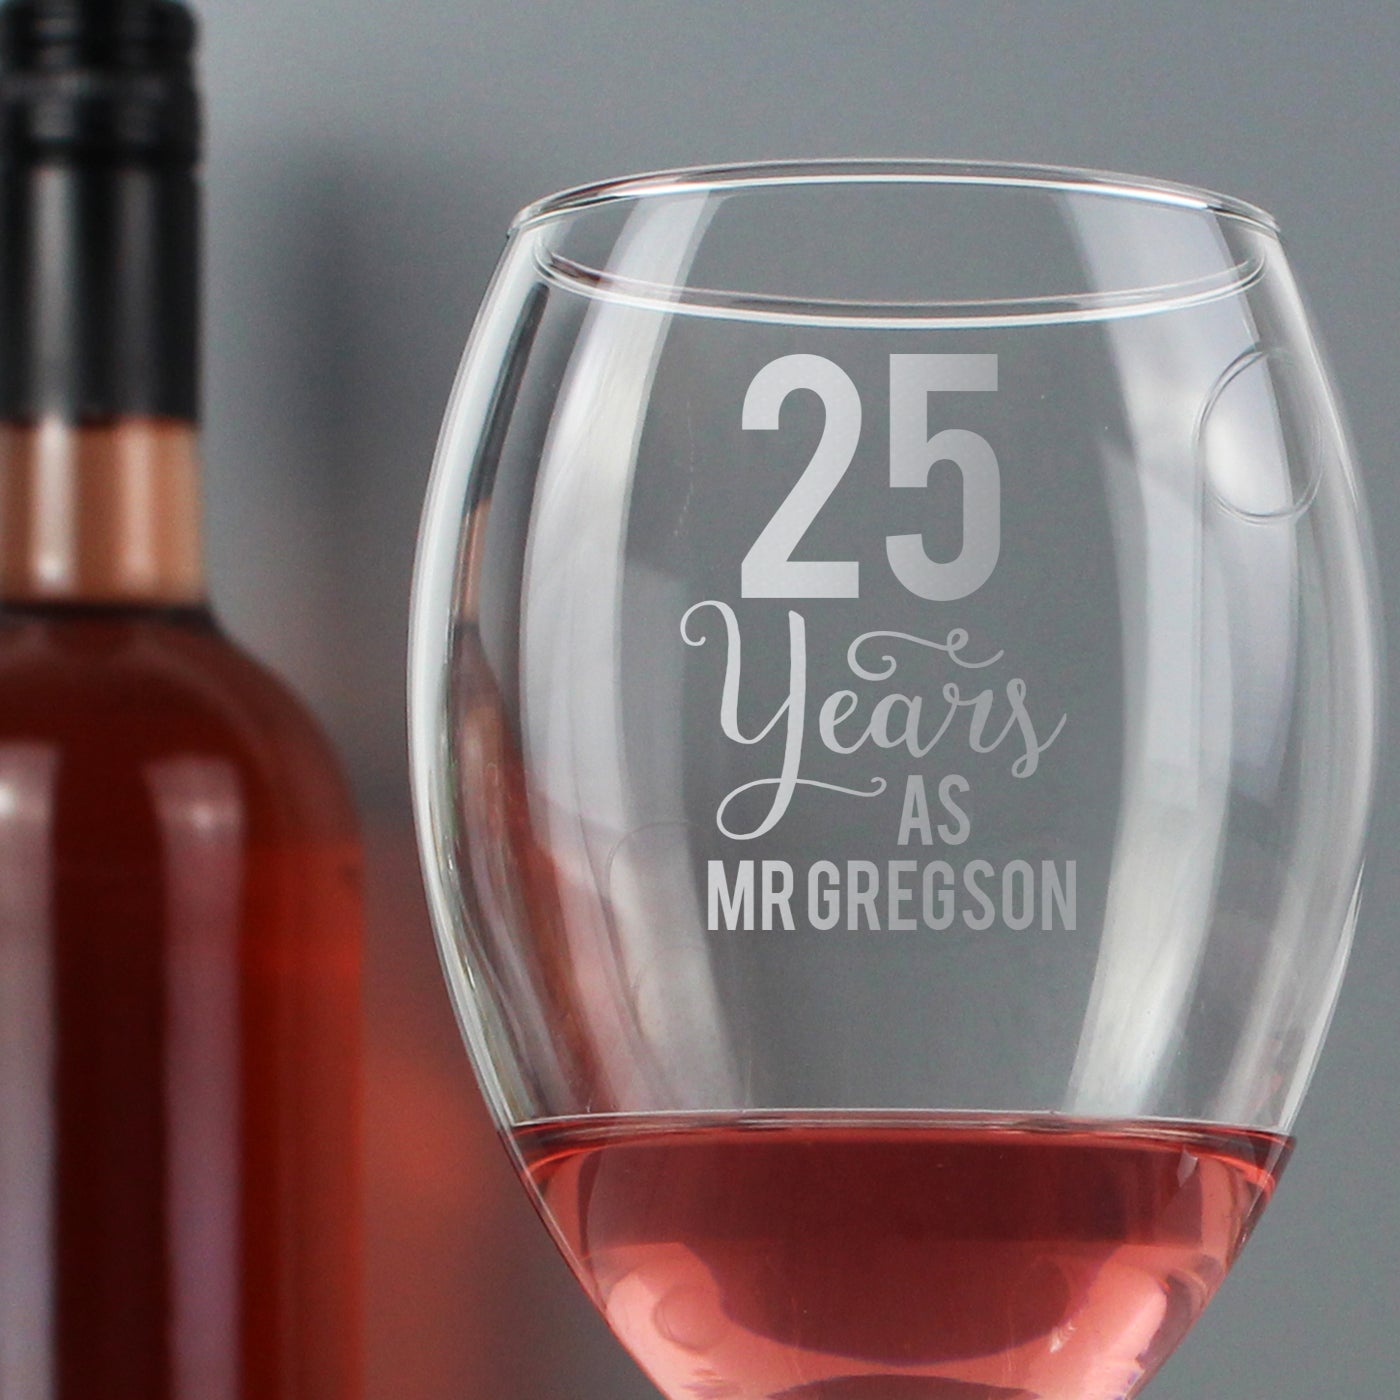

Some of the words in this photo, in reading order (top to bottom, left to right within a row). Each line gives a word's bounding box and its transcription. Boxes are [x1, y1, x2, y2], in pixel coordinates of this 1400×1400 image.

[742, 352, 1001, 602] 25
[679, 600, 1068, 841] Years
[897, 774, 971, 847] AS
[707, 859, 796, 932] MR
[807, 859, 1078, 932] GREGSON
